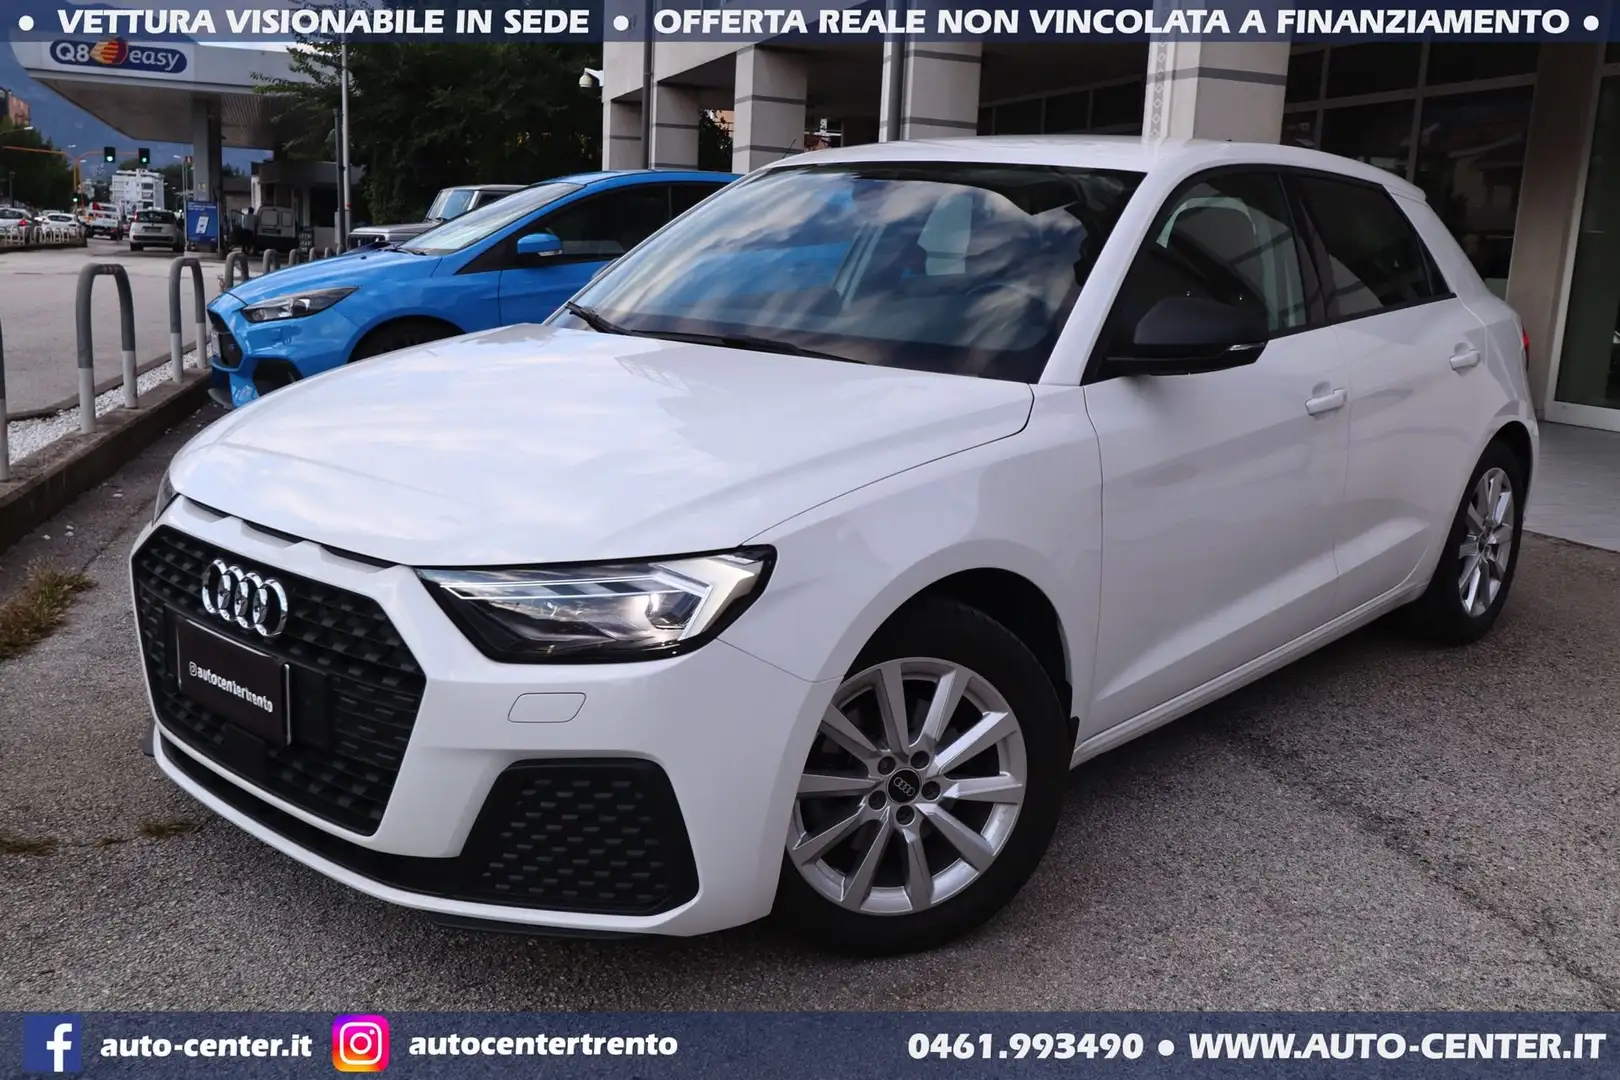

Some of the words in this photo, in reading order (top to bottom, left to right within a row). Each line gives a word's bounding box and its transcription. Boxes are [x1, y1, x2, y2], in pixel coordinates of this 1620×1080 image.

[55, 42, 90, 63] Q8
[129, 49, 180, 71] easy
[188, 660, 274, 714] @autocentertrento
